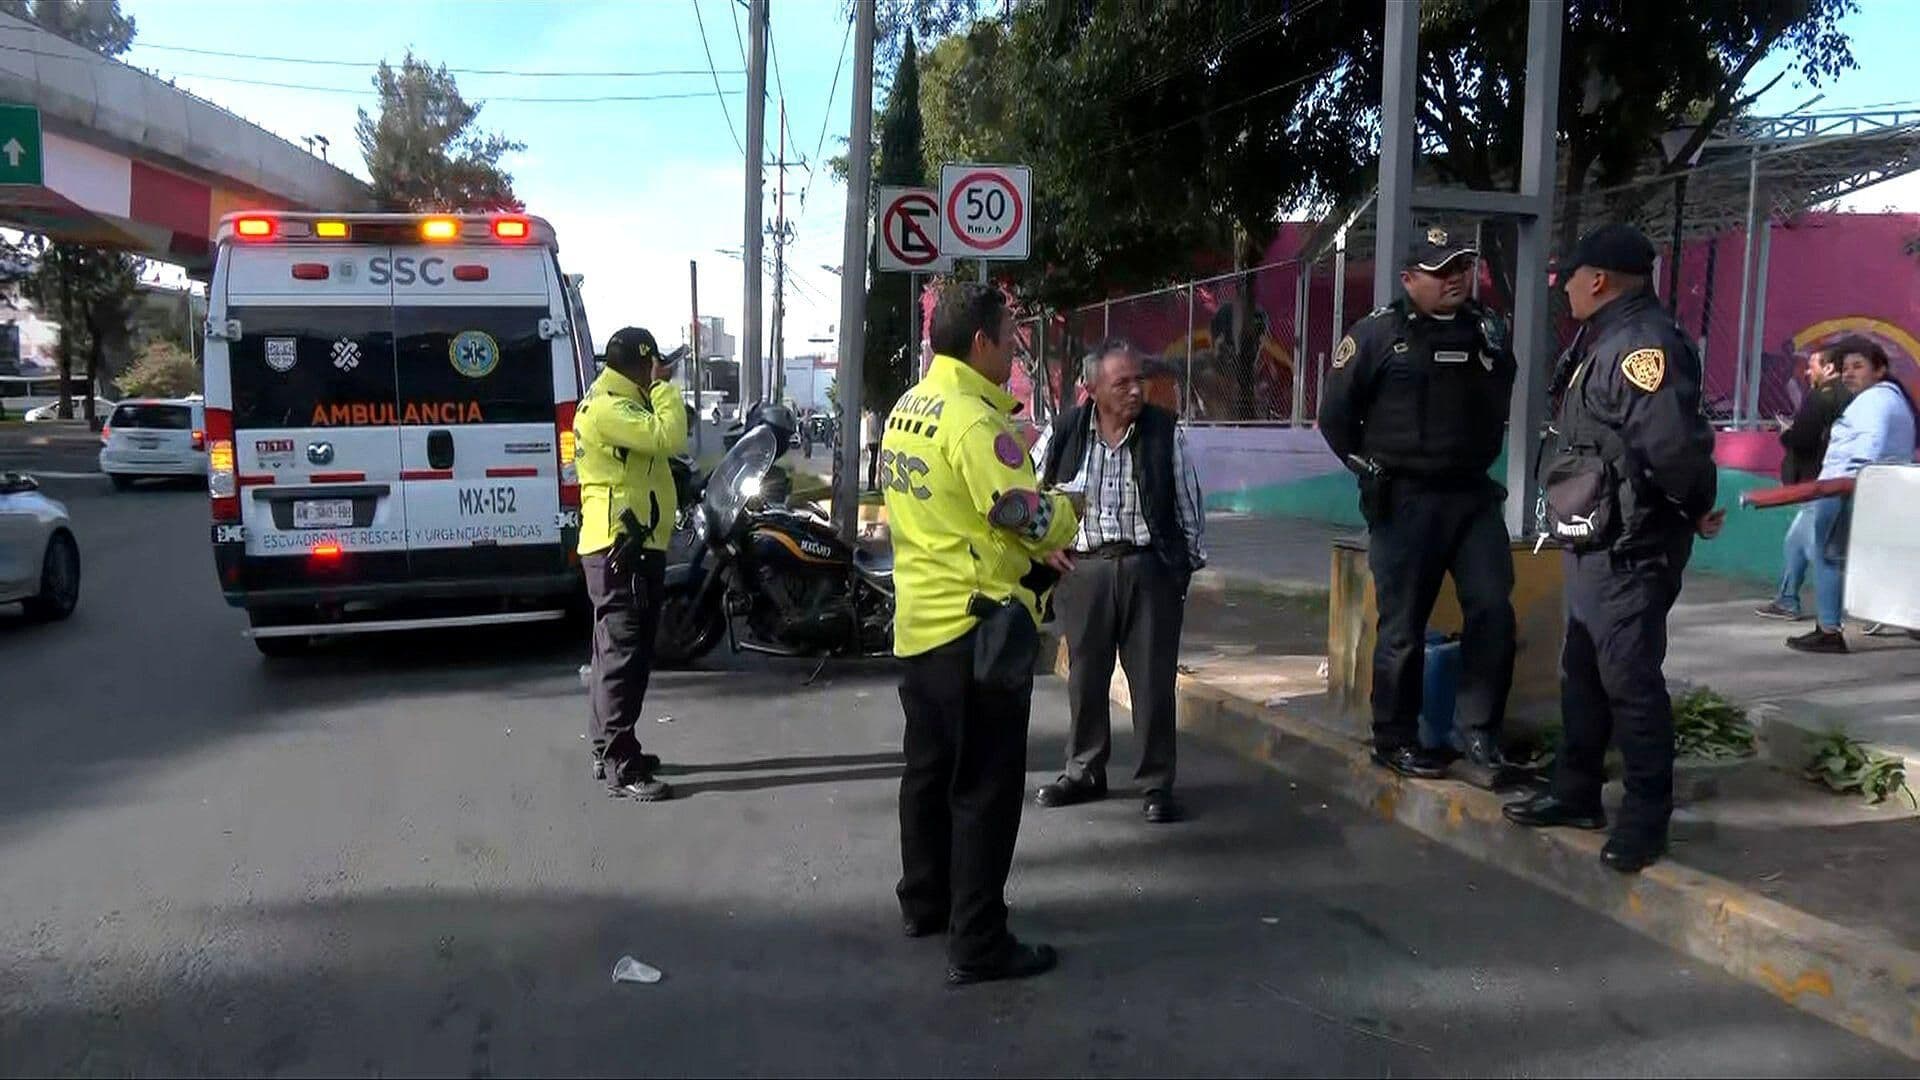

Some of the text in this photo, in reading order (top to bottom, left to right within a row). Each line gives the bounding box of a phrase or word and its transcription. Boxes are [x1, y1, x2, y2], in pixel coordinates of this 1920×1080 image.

[966, 187, 1006, 222] 50
[369, 257, 445, 286] SSC
[312, 401, 484, 426] AMBULANCIA
[459, 486, 517, 516] MX-152
